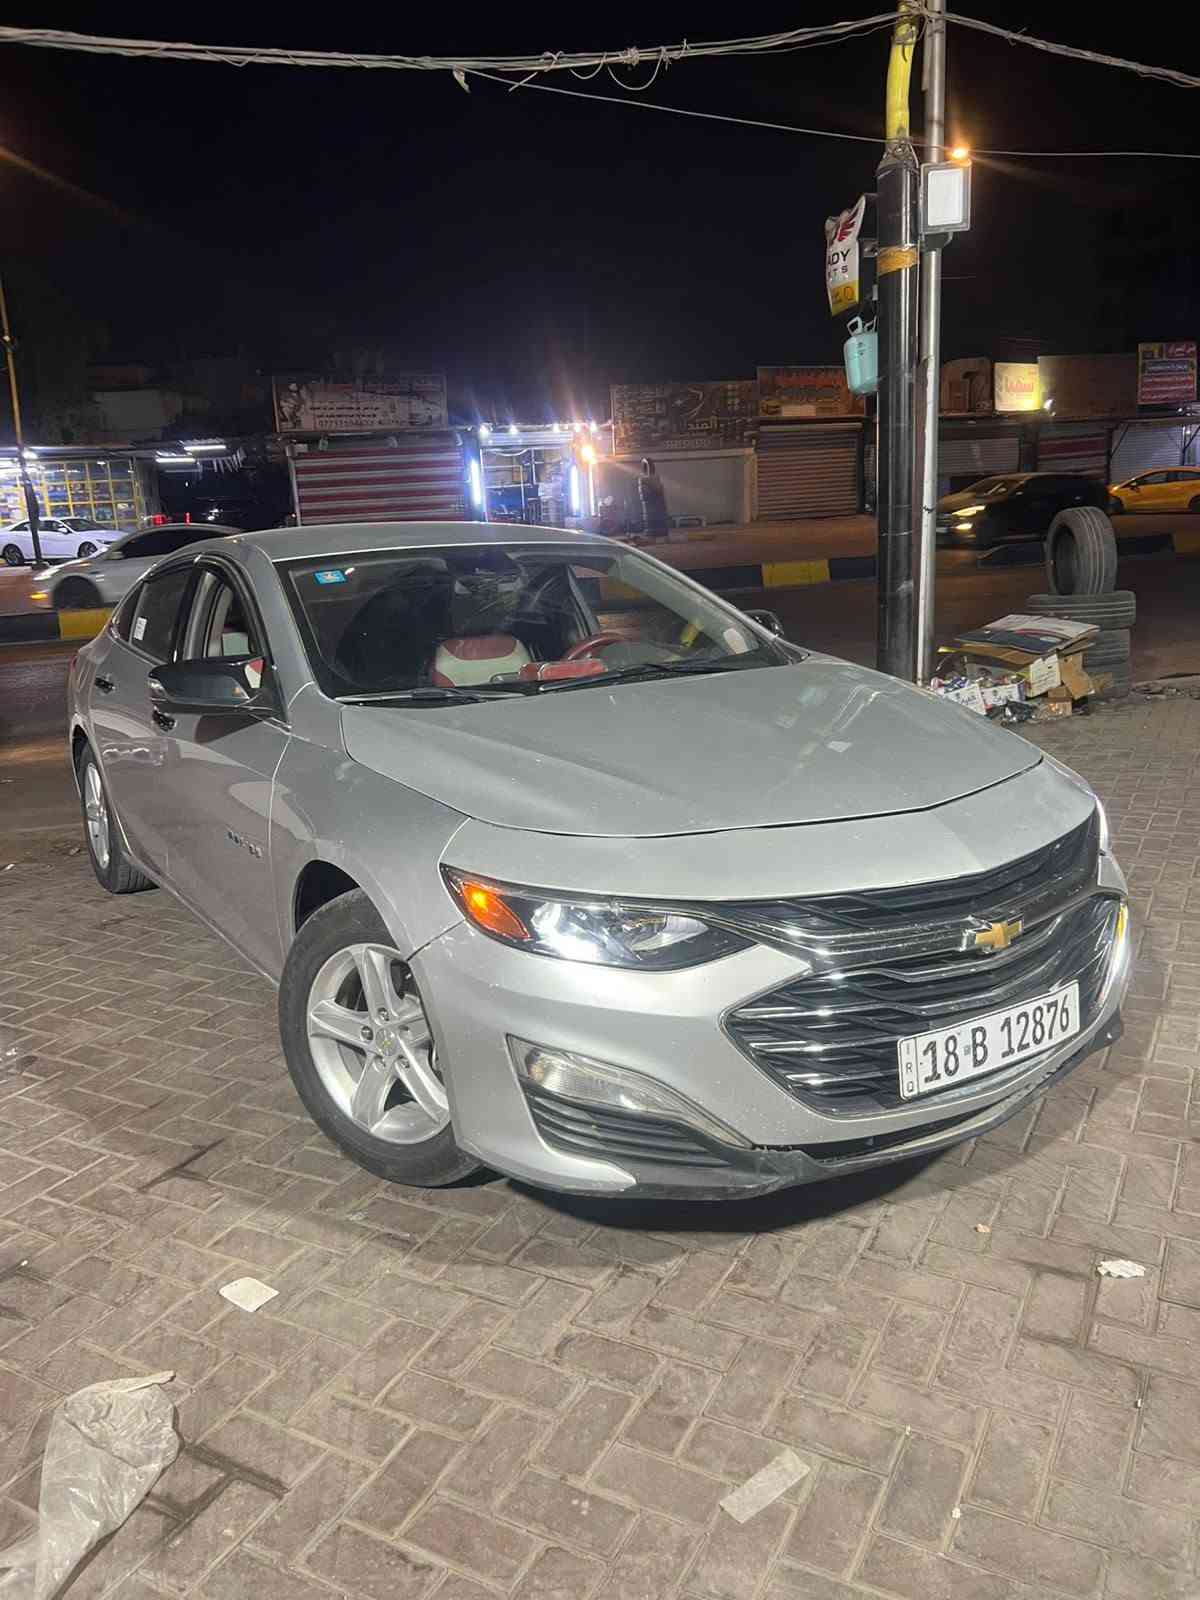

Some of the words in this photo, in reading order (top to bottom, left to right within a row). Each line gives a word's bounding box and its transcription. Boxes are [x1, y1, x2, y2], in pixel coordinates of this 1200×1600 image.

[828, 248, 852, 266] DY
[922, 1034, 960, 1083] 18
[971, 1025, 989, 1068] B
[1001, 994, 1070, 1058] 12876
